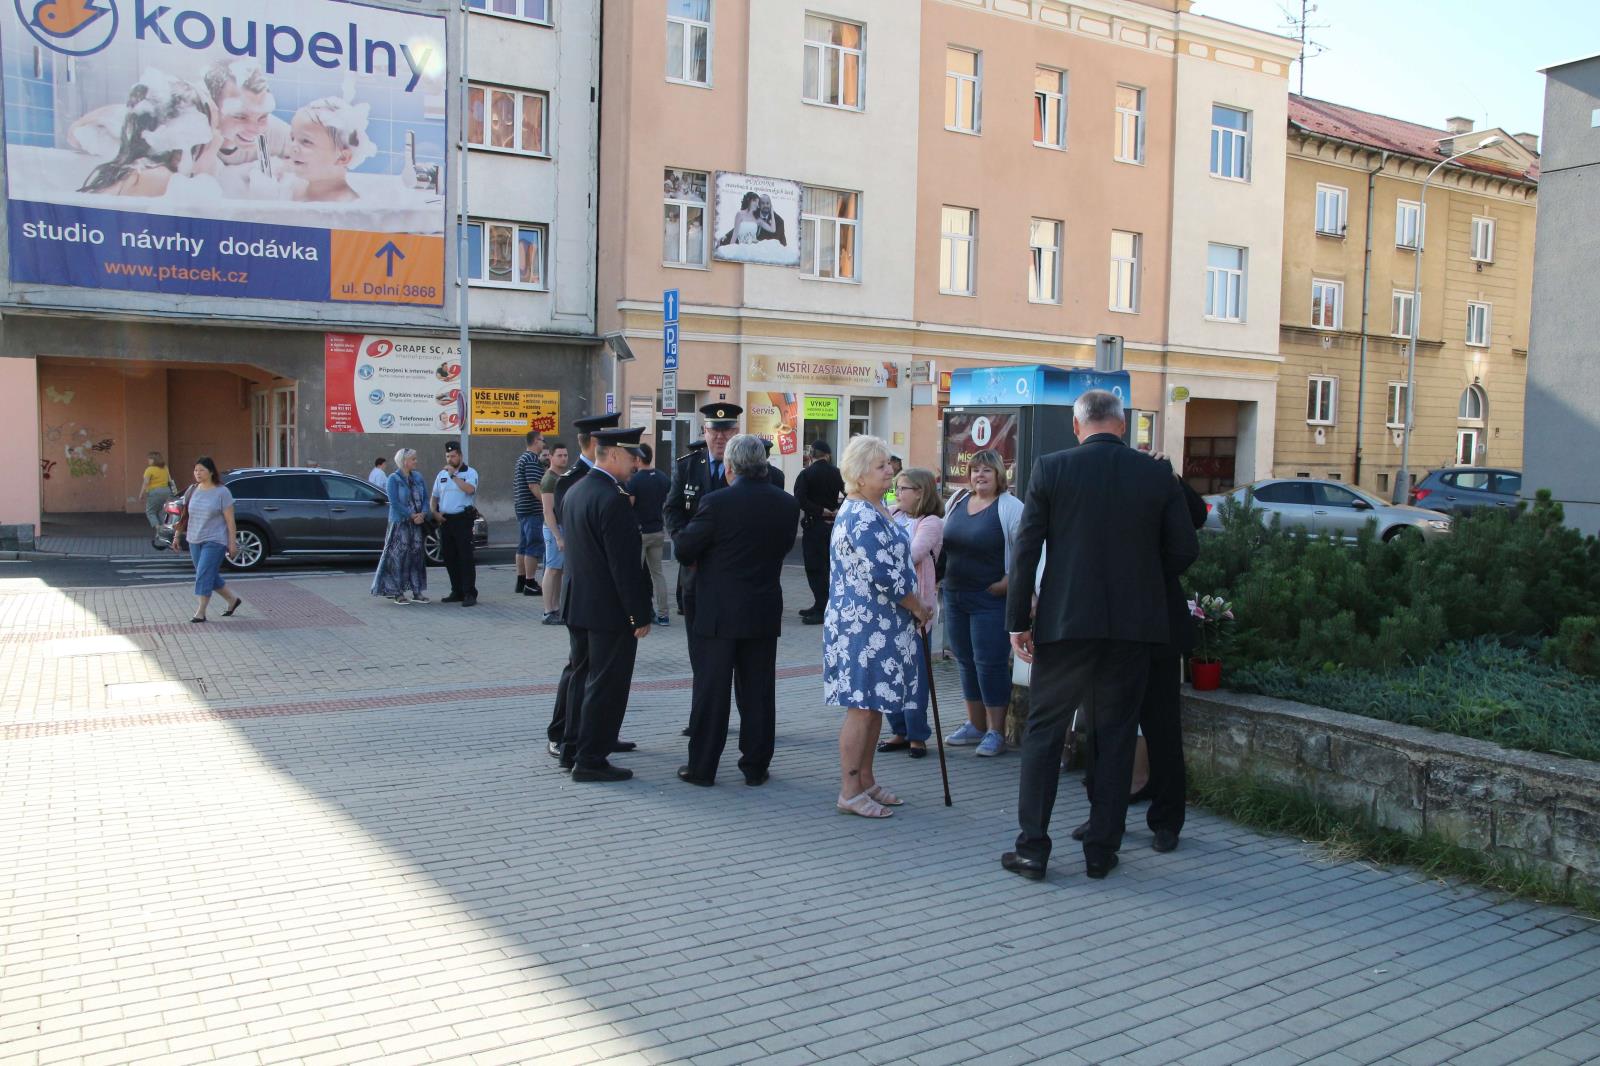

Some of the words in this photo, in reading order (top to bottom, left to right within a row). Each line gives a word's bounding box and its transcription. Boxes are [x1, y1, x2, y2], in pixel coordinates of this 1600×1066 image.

[135, 0, 432, 92] koupelny
[22, 219, 104, 245] studio
[121, 228, 204, 257] návrhy
[219, 235, 319, 261] dodávka
[104, 260, 248, 284] www.ptacek.cz
[341, 281, 358, 294] ul.
[403, 284, 436, 298] 3868
[394, 344, 426, 353] GRAPE
[430, 346, 444, 355] SC,
[666, 328, 675, 354] P
[776, 360, 810, 374] MISTŘI
[812, 363, 871, 377] ZASTAVÁRNY
[474, 391, 491, 400] VŠE
[493, 391, 520, 401] LEVNĚ
[810, 399, 832, 408] VÝKUP
[503, 410, 516, 418] 50
[751, 406, 775, 416] servis
